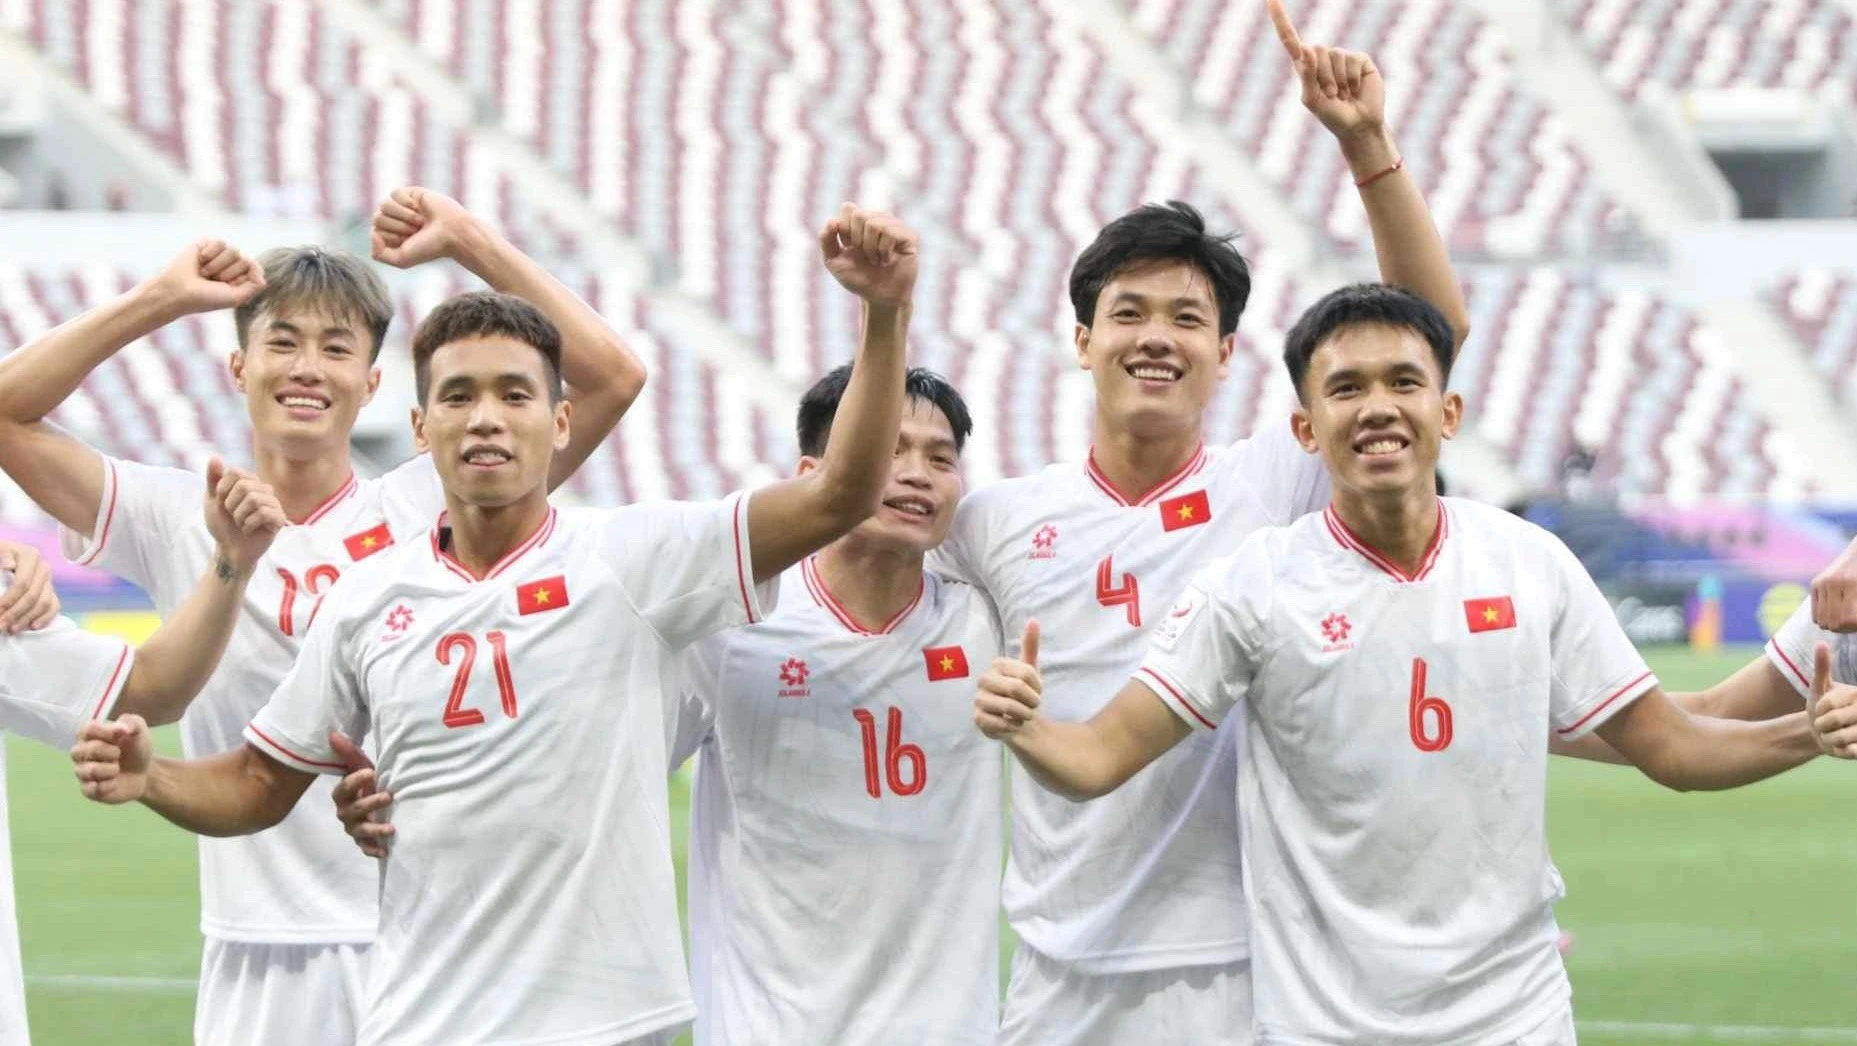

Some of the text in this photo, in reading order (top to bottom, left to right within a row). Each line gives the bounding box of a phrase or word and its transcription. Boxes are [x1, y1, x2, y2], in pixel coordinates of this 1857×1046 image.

[1095, 555, 1143, 628] 4
[434, 631, 519, 728] 21
[1408, 657, 1454, 752] 6
[852, 706, 928, 799] 16
